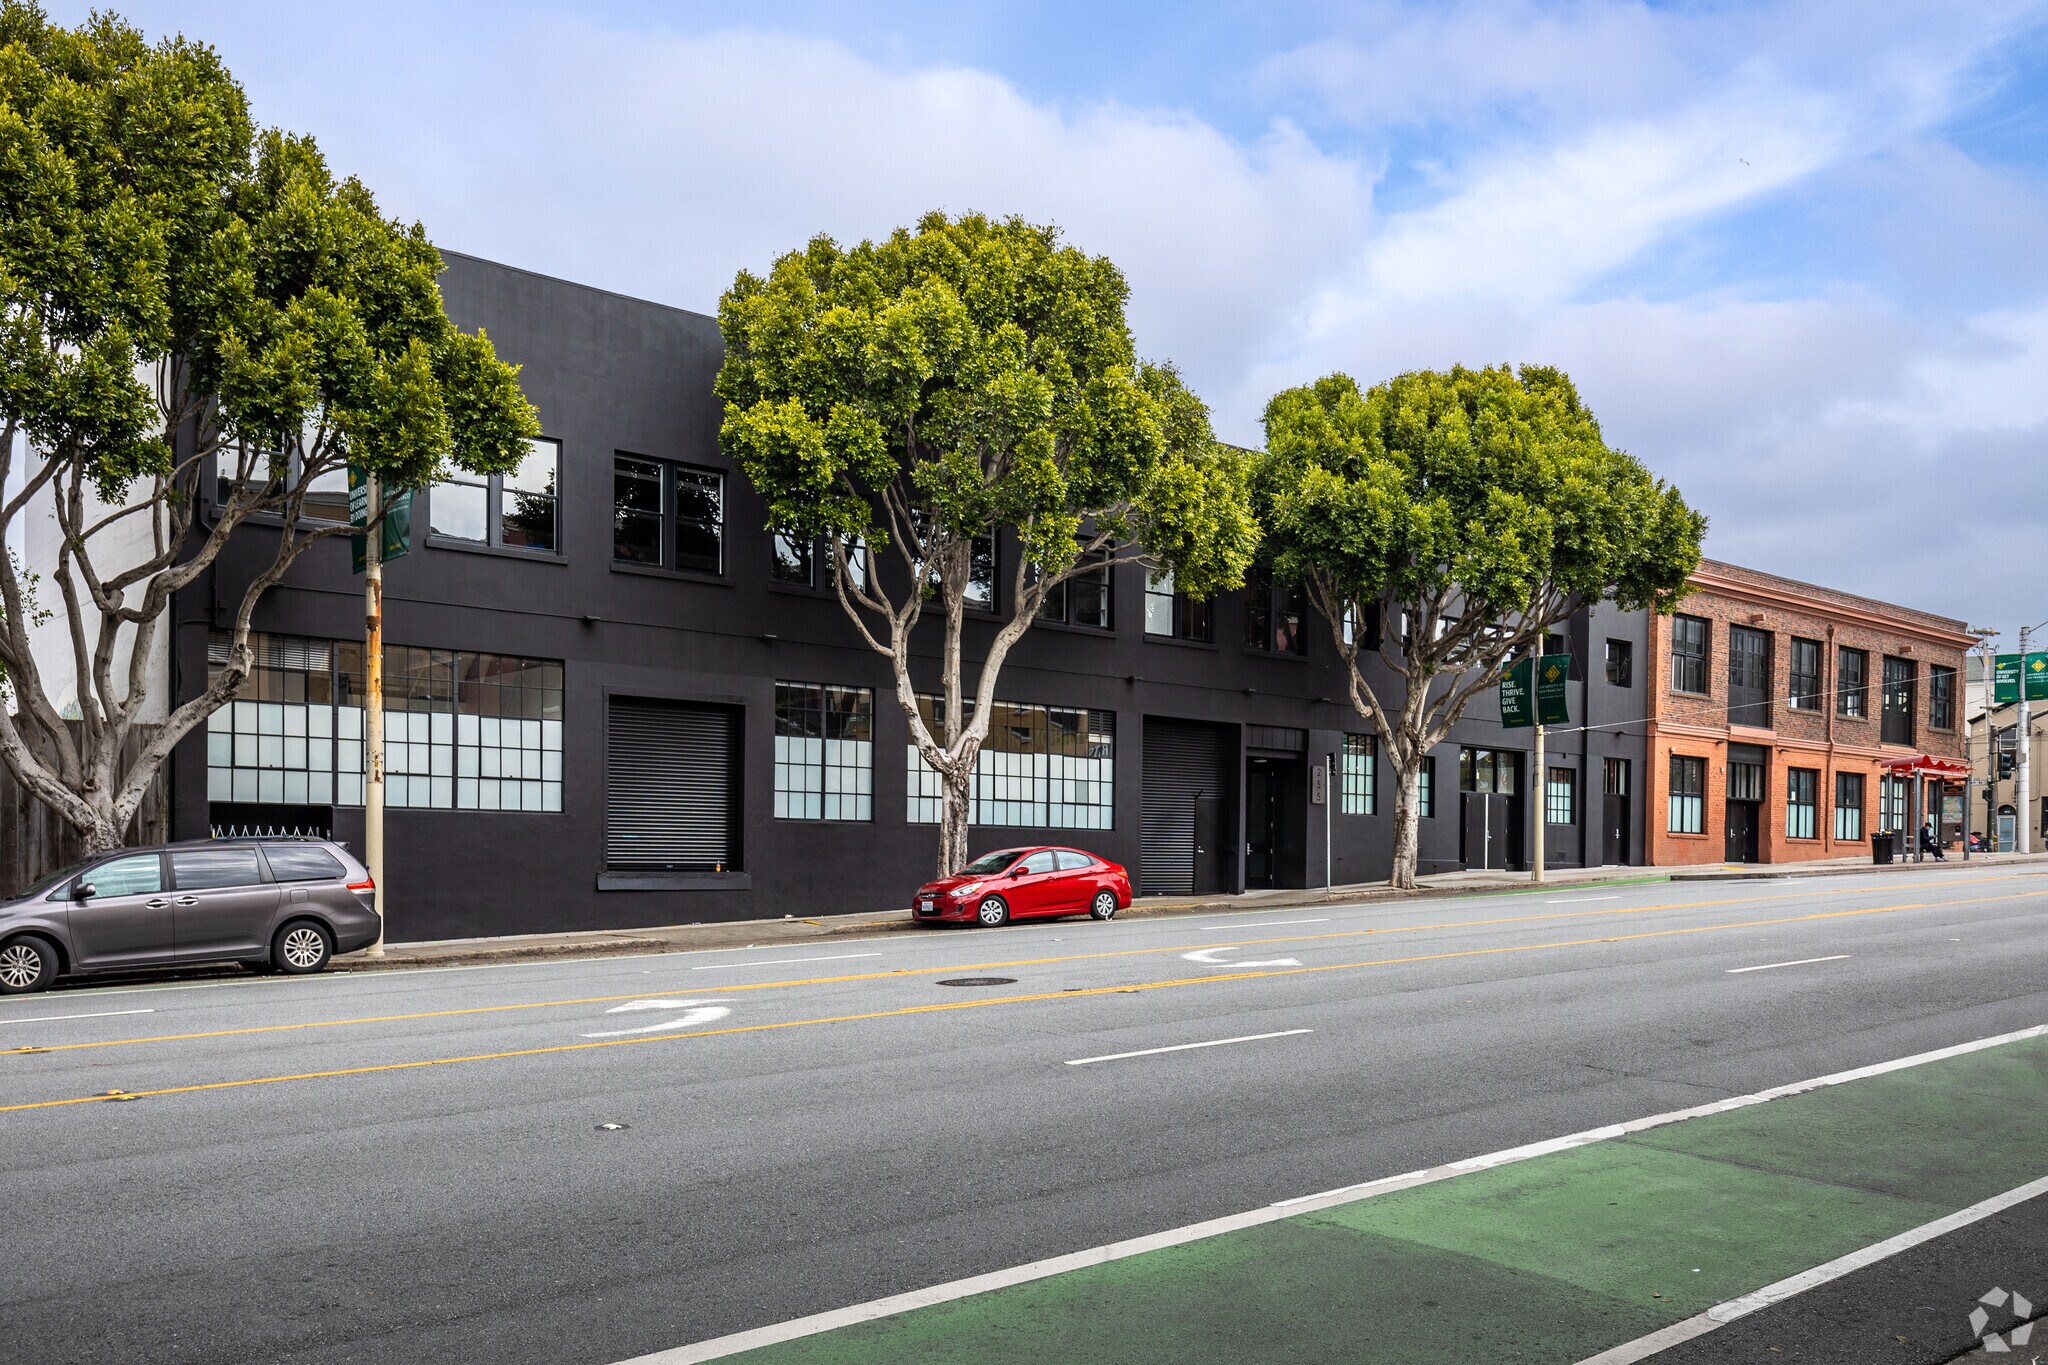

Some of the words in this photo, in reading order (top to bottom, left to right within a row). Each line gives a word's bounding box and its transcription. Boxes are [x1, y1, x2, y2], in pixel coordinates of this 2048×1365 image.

[1502, 681, 1516, 689] RISE.
[1502, 687, 1525, 697] THRIVE.
[1502, 697, 1516, 705] GIVE
[1502, 705, 1520, 714] BACK.
